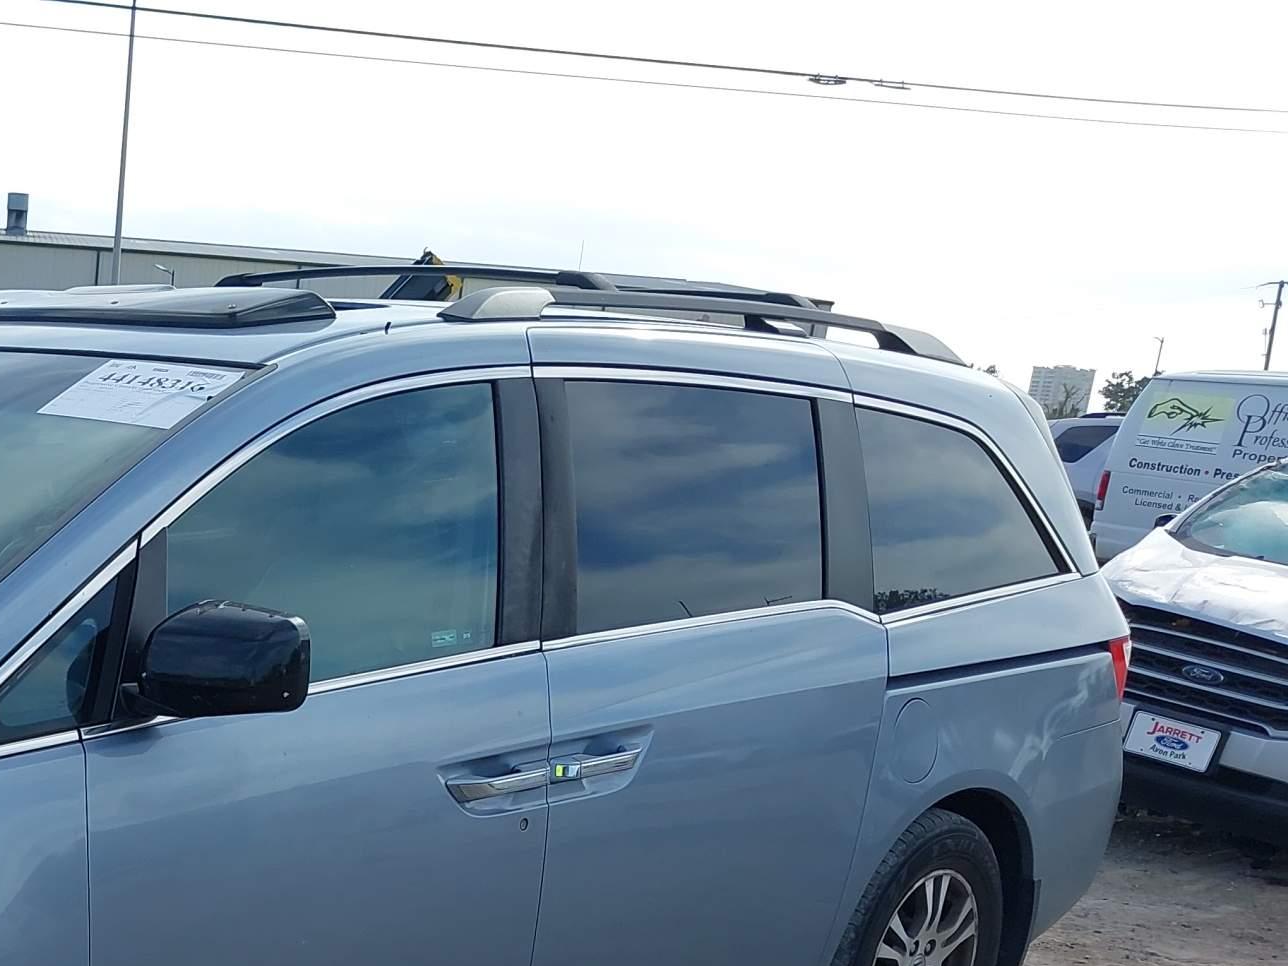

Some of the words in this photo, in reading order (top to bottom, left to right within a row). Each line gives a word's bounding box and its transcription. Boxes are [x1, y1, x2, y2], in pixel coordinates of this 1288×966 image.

[98, 371, 209, 392] 44148316
[1237, 394, 1288, 425] Offi
[1232, 414, 1288, 451] Profes
[1129, 457, 1201, 477] Construction
[1122, 485, 1173, 499] Commercial
[1134, 498, 1173, 511] Licensed
[1147, 721, 1203, 744] JARRETT
[1149, 744, 1169, 756] Avon
[1169, 748, 1187, 761] Park
